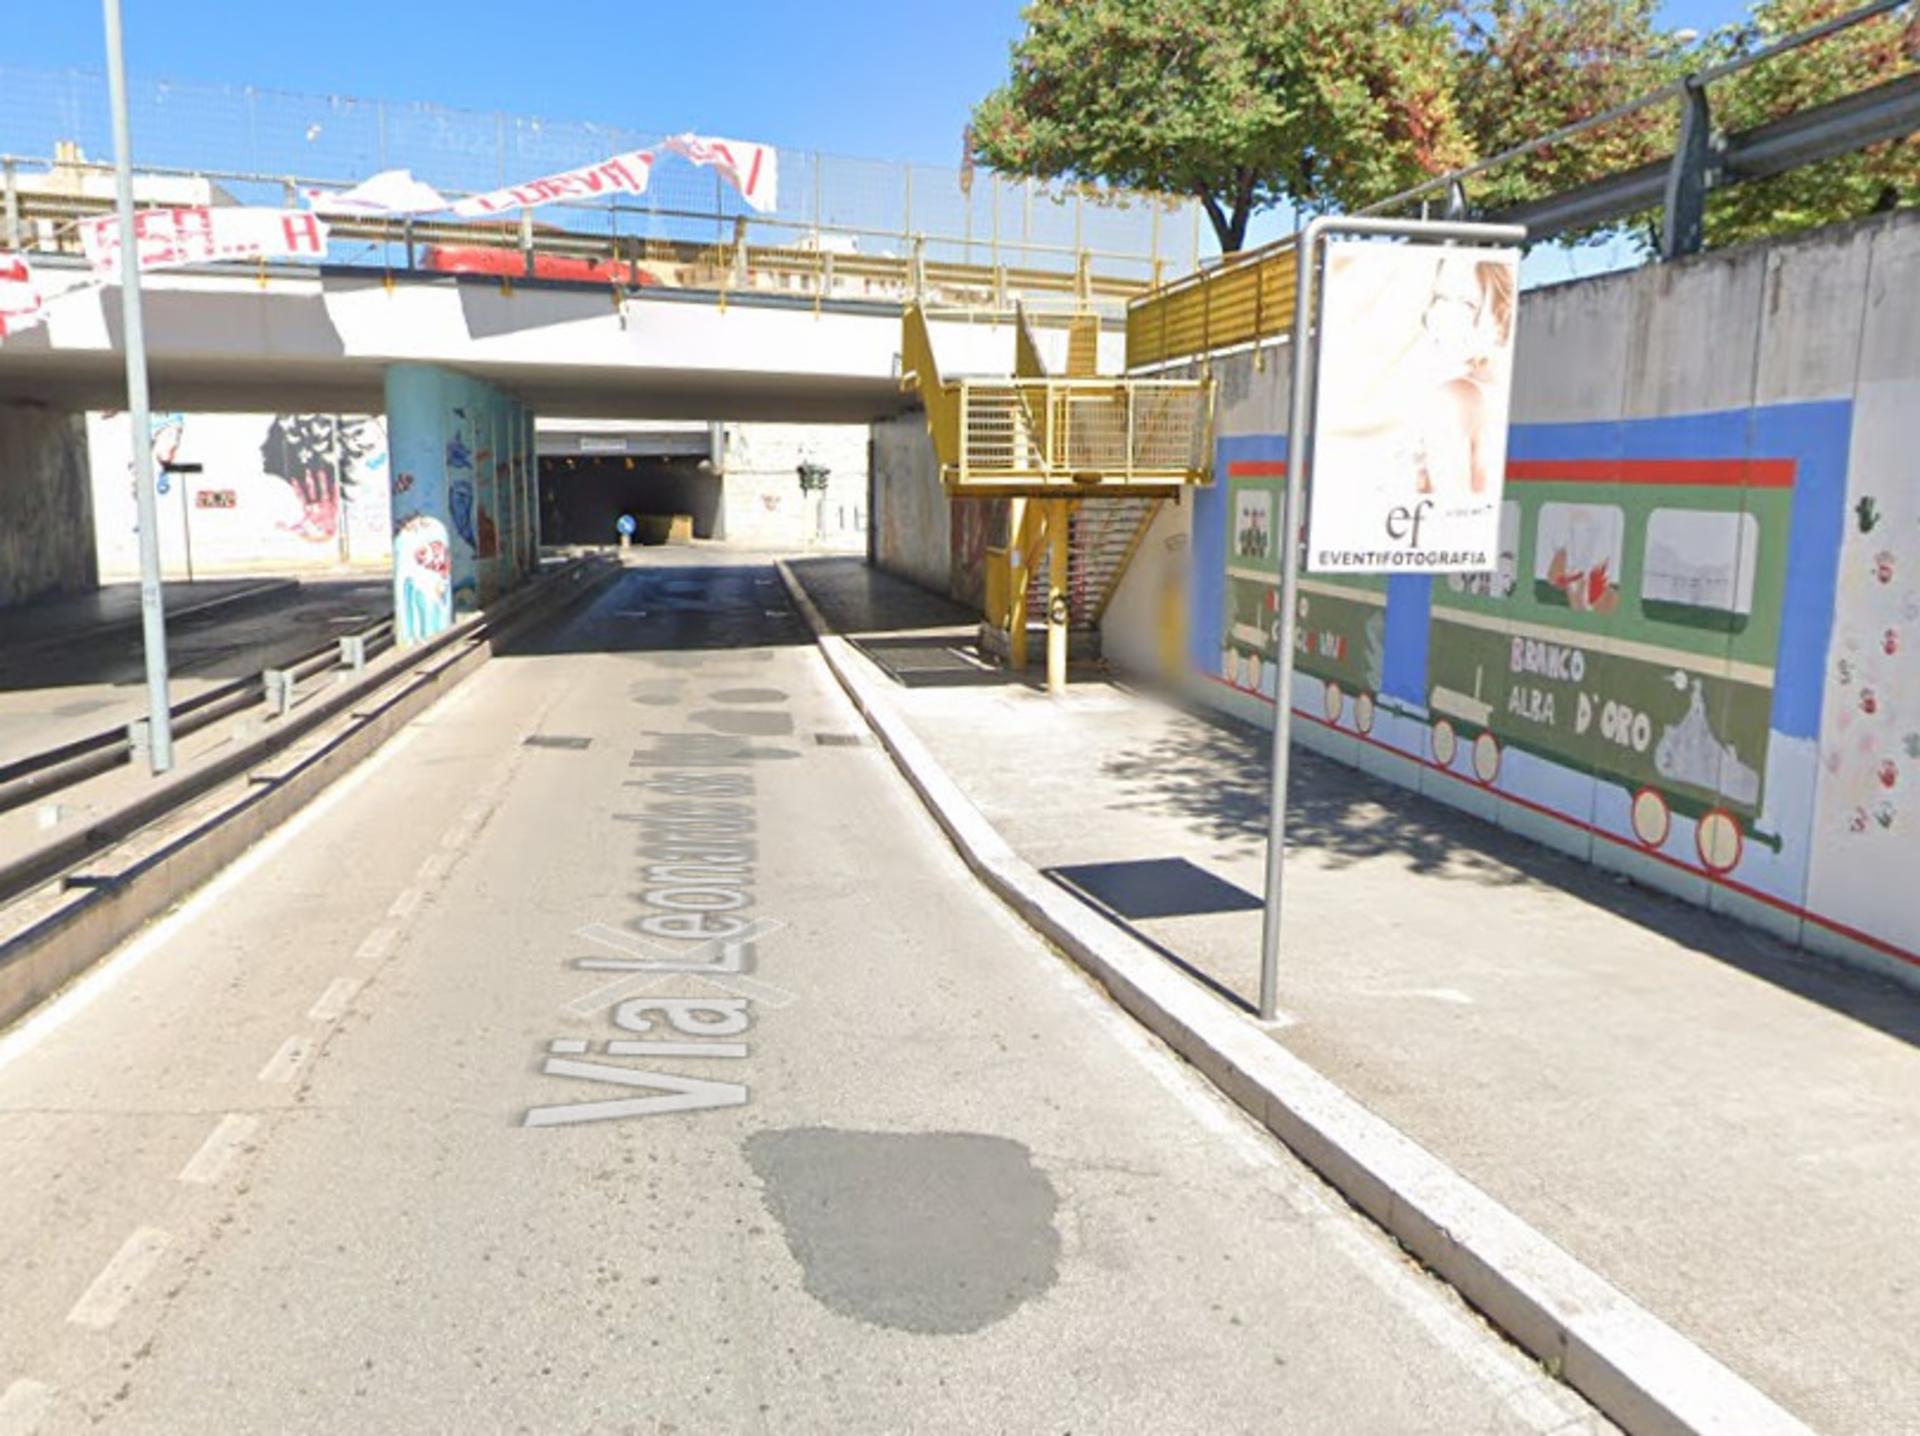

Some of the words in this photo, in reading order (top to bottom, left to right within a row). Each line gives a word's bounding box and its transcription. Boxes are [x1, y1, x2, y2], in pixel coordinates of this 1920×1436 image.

[1385, 499, 1434, 548] ef
[1318, 550, 1487, 568] EVENTIFOTOGRAFIA
[1508, 686, 1556, 726] ALBA
